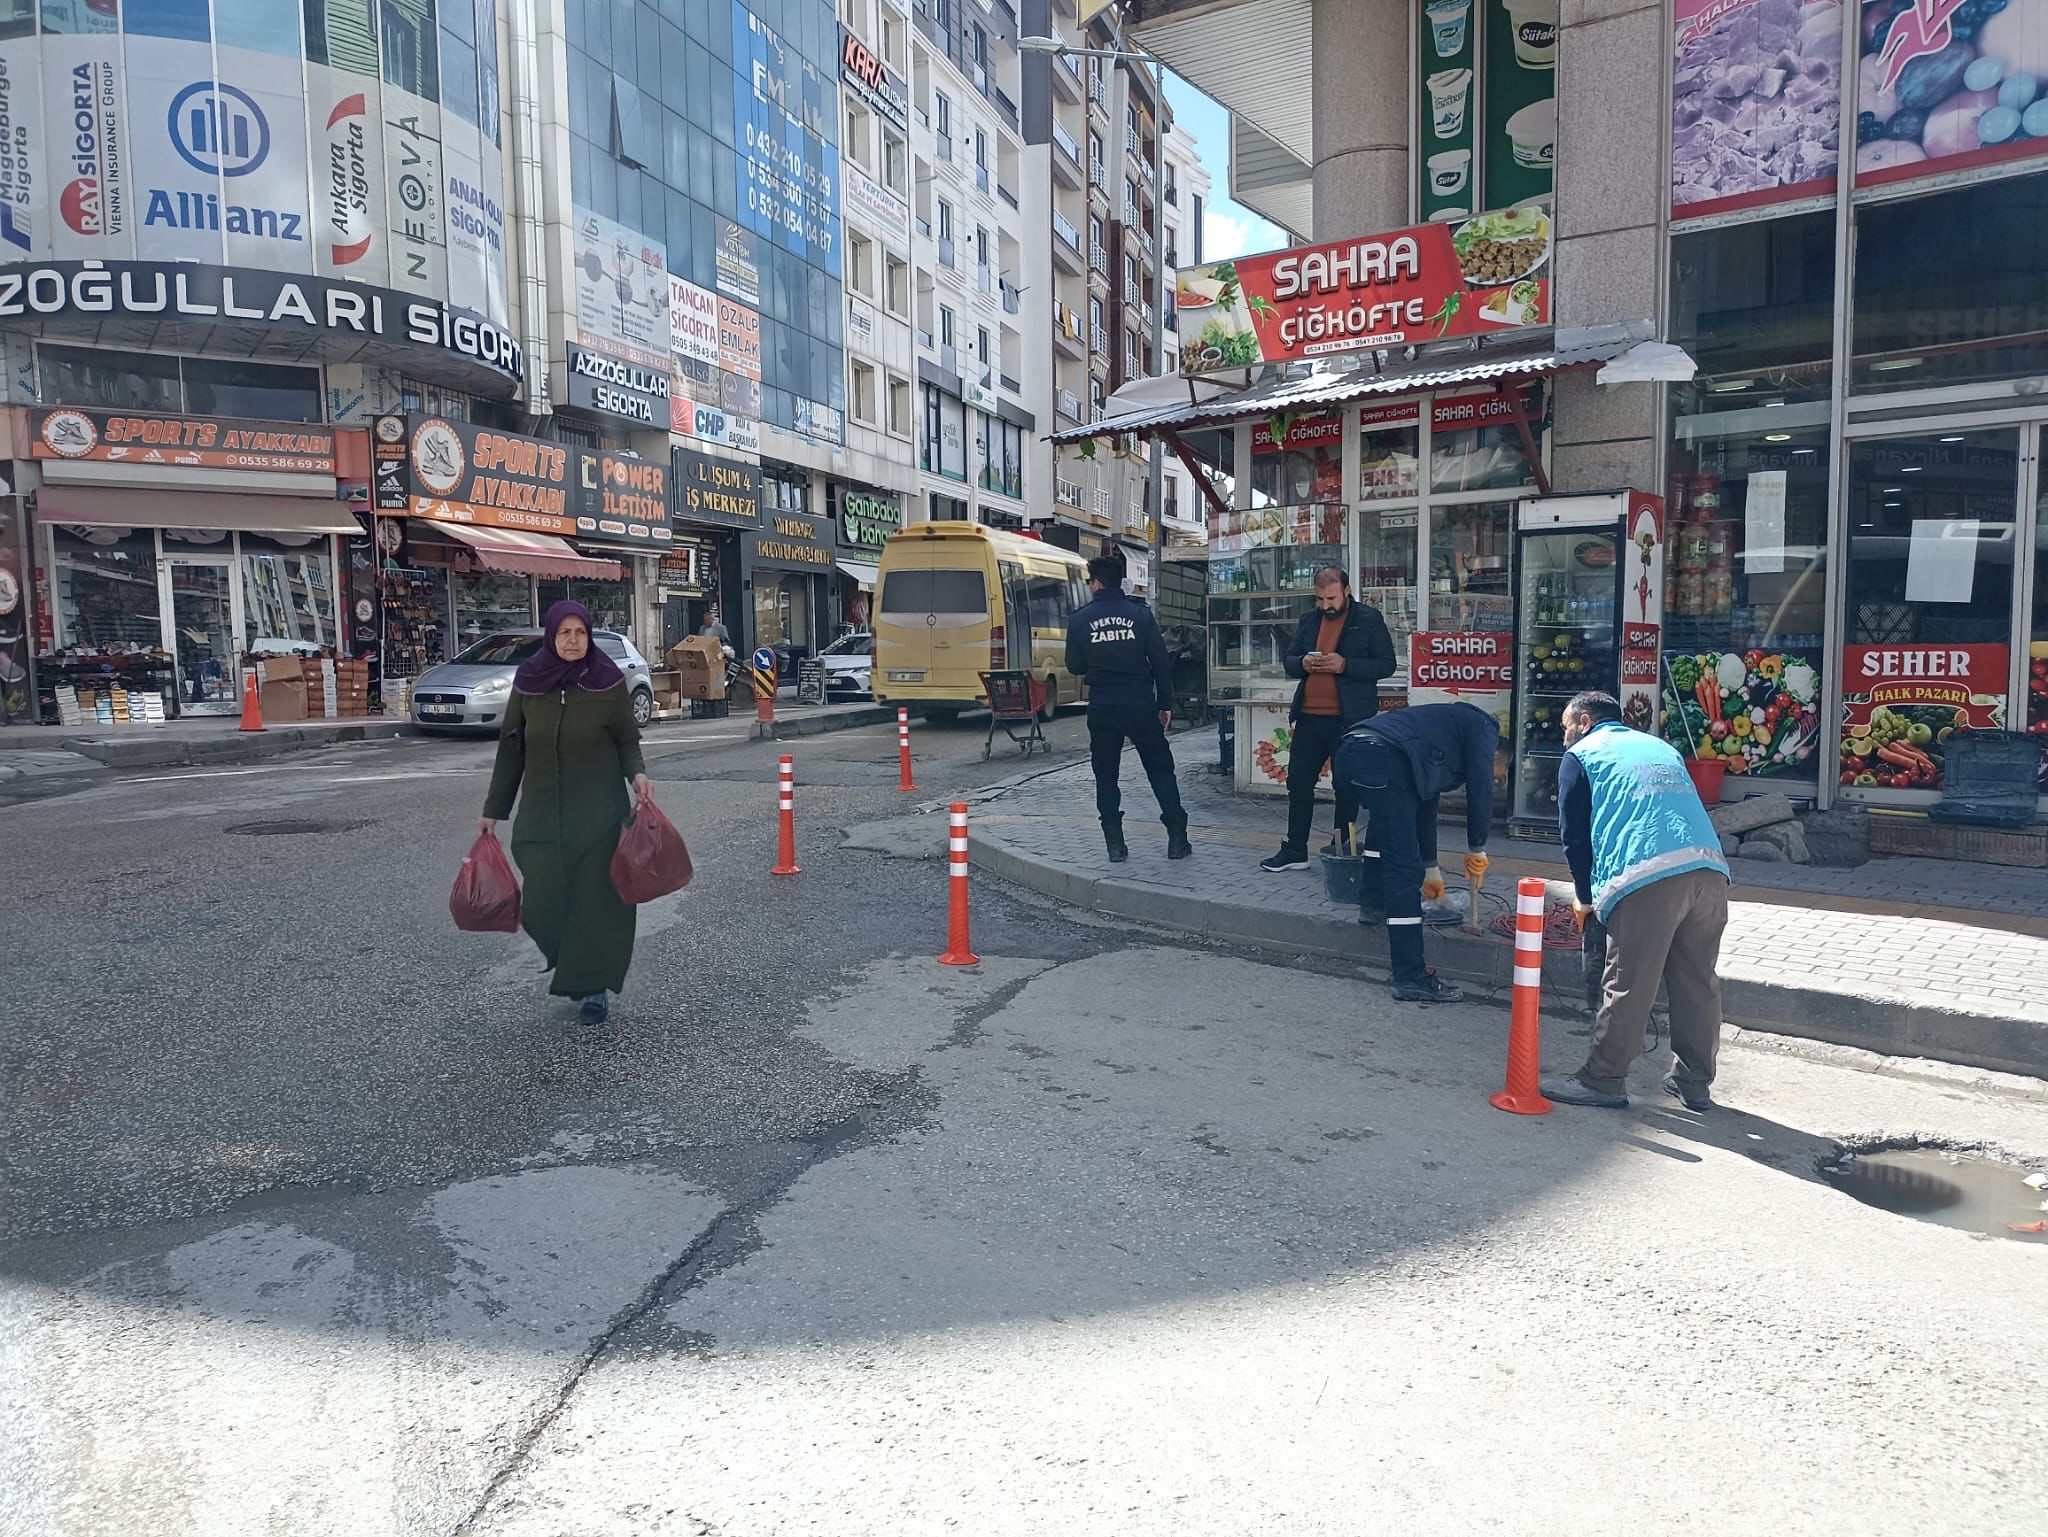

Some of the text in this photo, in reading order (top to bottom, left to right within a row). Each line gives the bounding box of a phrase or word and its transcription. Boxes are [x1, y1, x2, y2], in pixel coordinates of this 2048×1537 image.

[757, 130, 779, 163] 432
[14, 125, 32, 205] Sigorta
[347, 122, 368, 214] Sigorta
[331, 142, 349, 235] Ankara
[399, 115, 428, 280] NEOVA
[79, 181, 100, 232] RAY
[144, 188, 303, 242] Allianz
[759, 192, 781, 224] 532
[783, 206, 804, 237] 054
[1273, 235, 1420, 300] SAHRA
[670, 282, 714, 317] TANCAN
[1279, 297, 1424, 349] ÇİĞKÖFTE
[721, 328, 759, 358] EMLAK
[597, 385, 653, 422] SİGORTA
[1434, 404, 1474, 422] SAHRA
[105, 417, 331, 455] SPORTS AYAKKABI
[695, 409, 725, 437] CHP
[239, 456, 330, 470] 0535 586 69 29
[472, 432, 567, 483] SPORTS
[601, 457, 664, 496] POWER
[743, 474, 752, 492] 4
[469, 475, 566, 516] AYAKKABI
[602, 487, 665, 522] İLETİŞİM
[703, 490, 757, 518] MERKEZİ
[845, 491, 901, 524] Ganibaba
[505, 513, 525, 525] 0535
[526, 515, 541, 527] 586
[541, 517, 551, 528] 69
[1089, 615, 1135, 632] İPEKYOLU
[1090, 628, 1136, 644] ZABITA
[1431, 637, 1498, 655] SAHRA
[1860, 650, 1971, 677] SEHER
[1417, 659, 1513, 684] ÇİĞKÖFTE
[1873, 687, 1967, 704] HALK PAZARI
